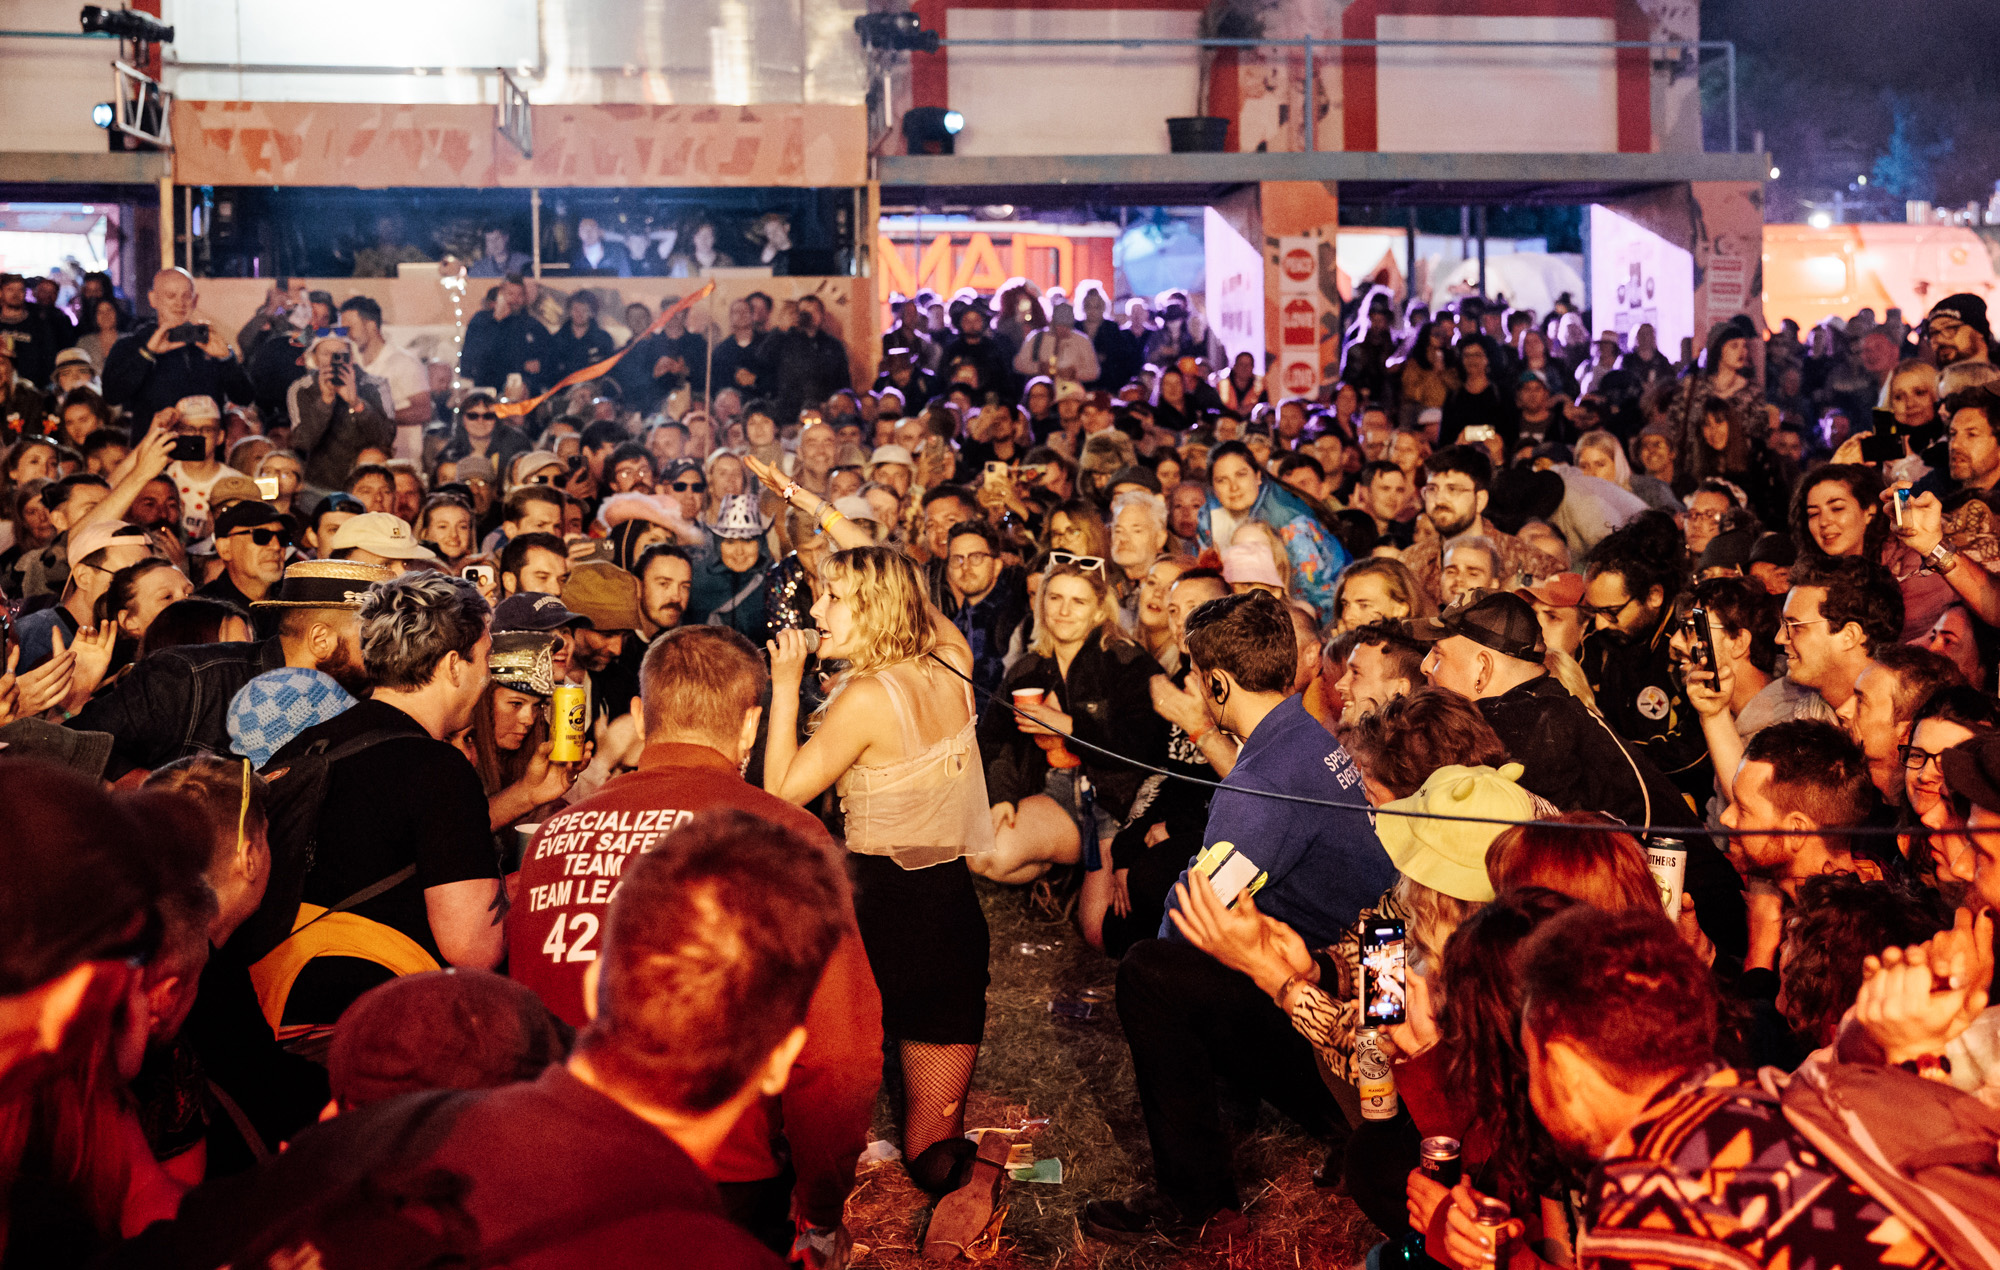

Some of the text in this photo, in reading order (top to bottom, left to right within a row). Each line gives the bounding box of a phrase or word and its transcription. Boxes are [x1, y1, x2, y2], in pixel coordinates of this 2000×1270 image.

[535, 832, 668, 860] EVENT SAFE
[564, 853, 626, 876] TEAM
[530, 880, 573, 912] TEAM
[542, 912, 600, 963] 42
